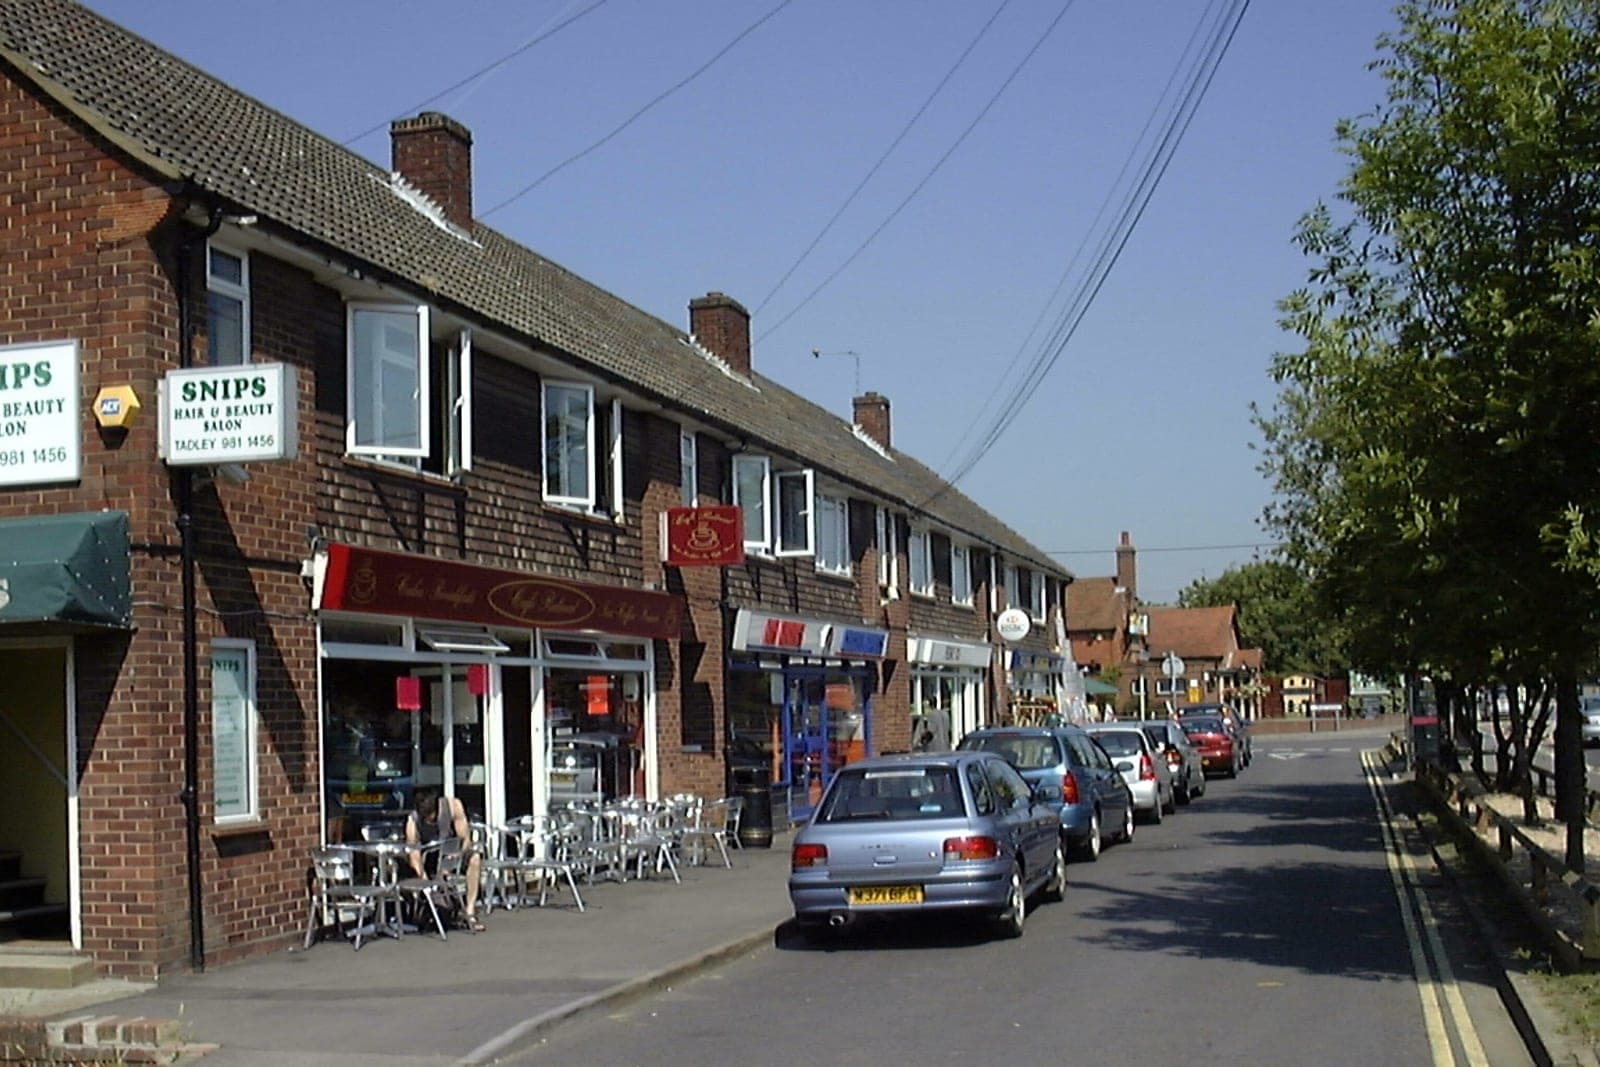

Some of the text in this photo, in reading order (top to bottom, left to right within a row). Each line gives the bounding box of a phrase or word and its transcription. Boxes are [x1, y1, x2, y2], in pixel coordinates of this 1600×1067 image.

[182, 377, 266, 402] SNIPS
[3, 398, 65, 418] BEAUTY
[174, 407, 205, 420] HAIR
[226, 403, 273, 417] BEAUTY
[203, 420, 242, 433] SALON
[175, 435, 274, 451] TADLEY 981 1456
[0, 446, 67, 466] 981 1456
